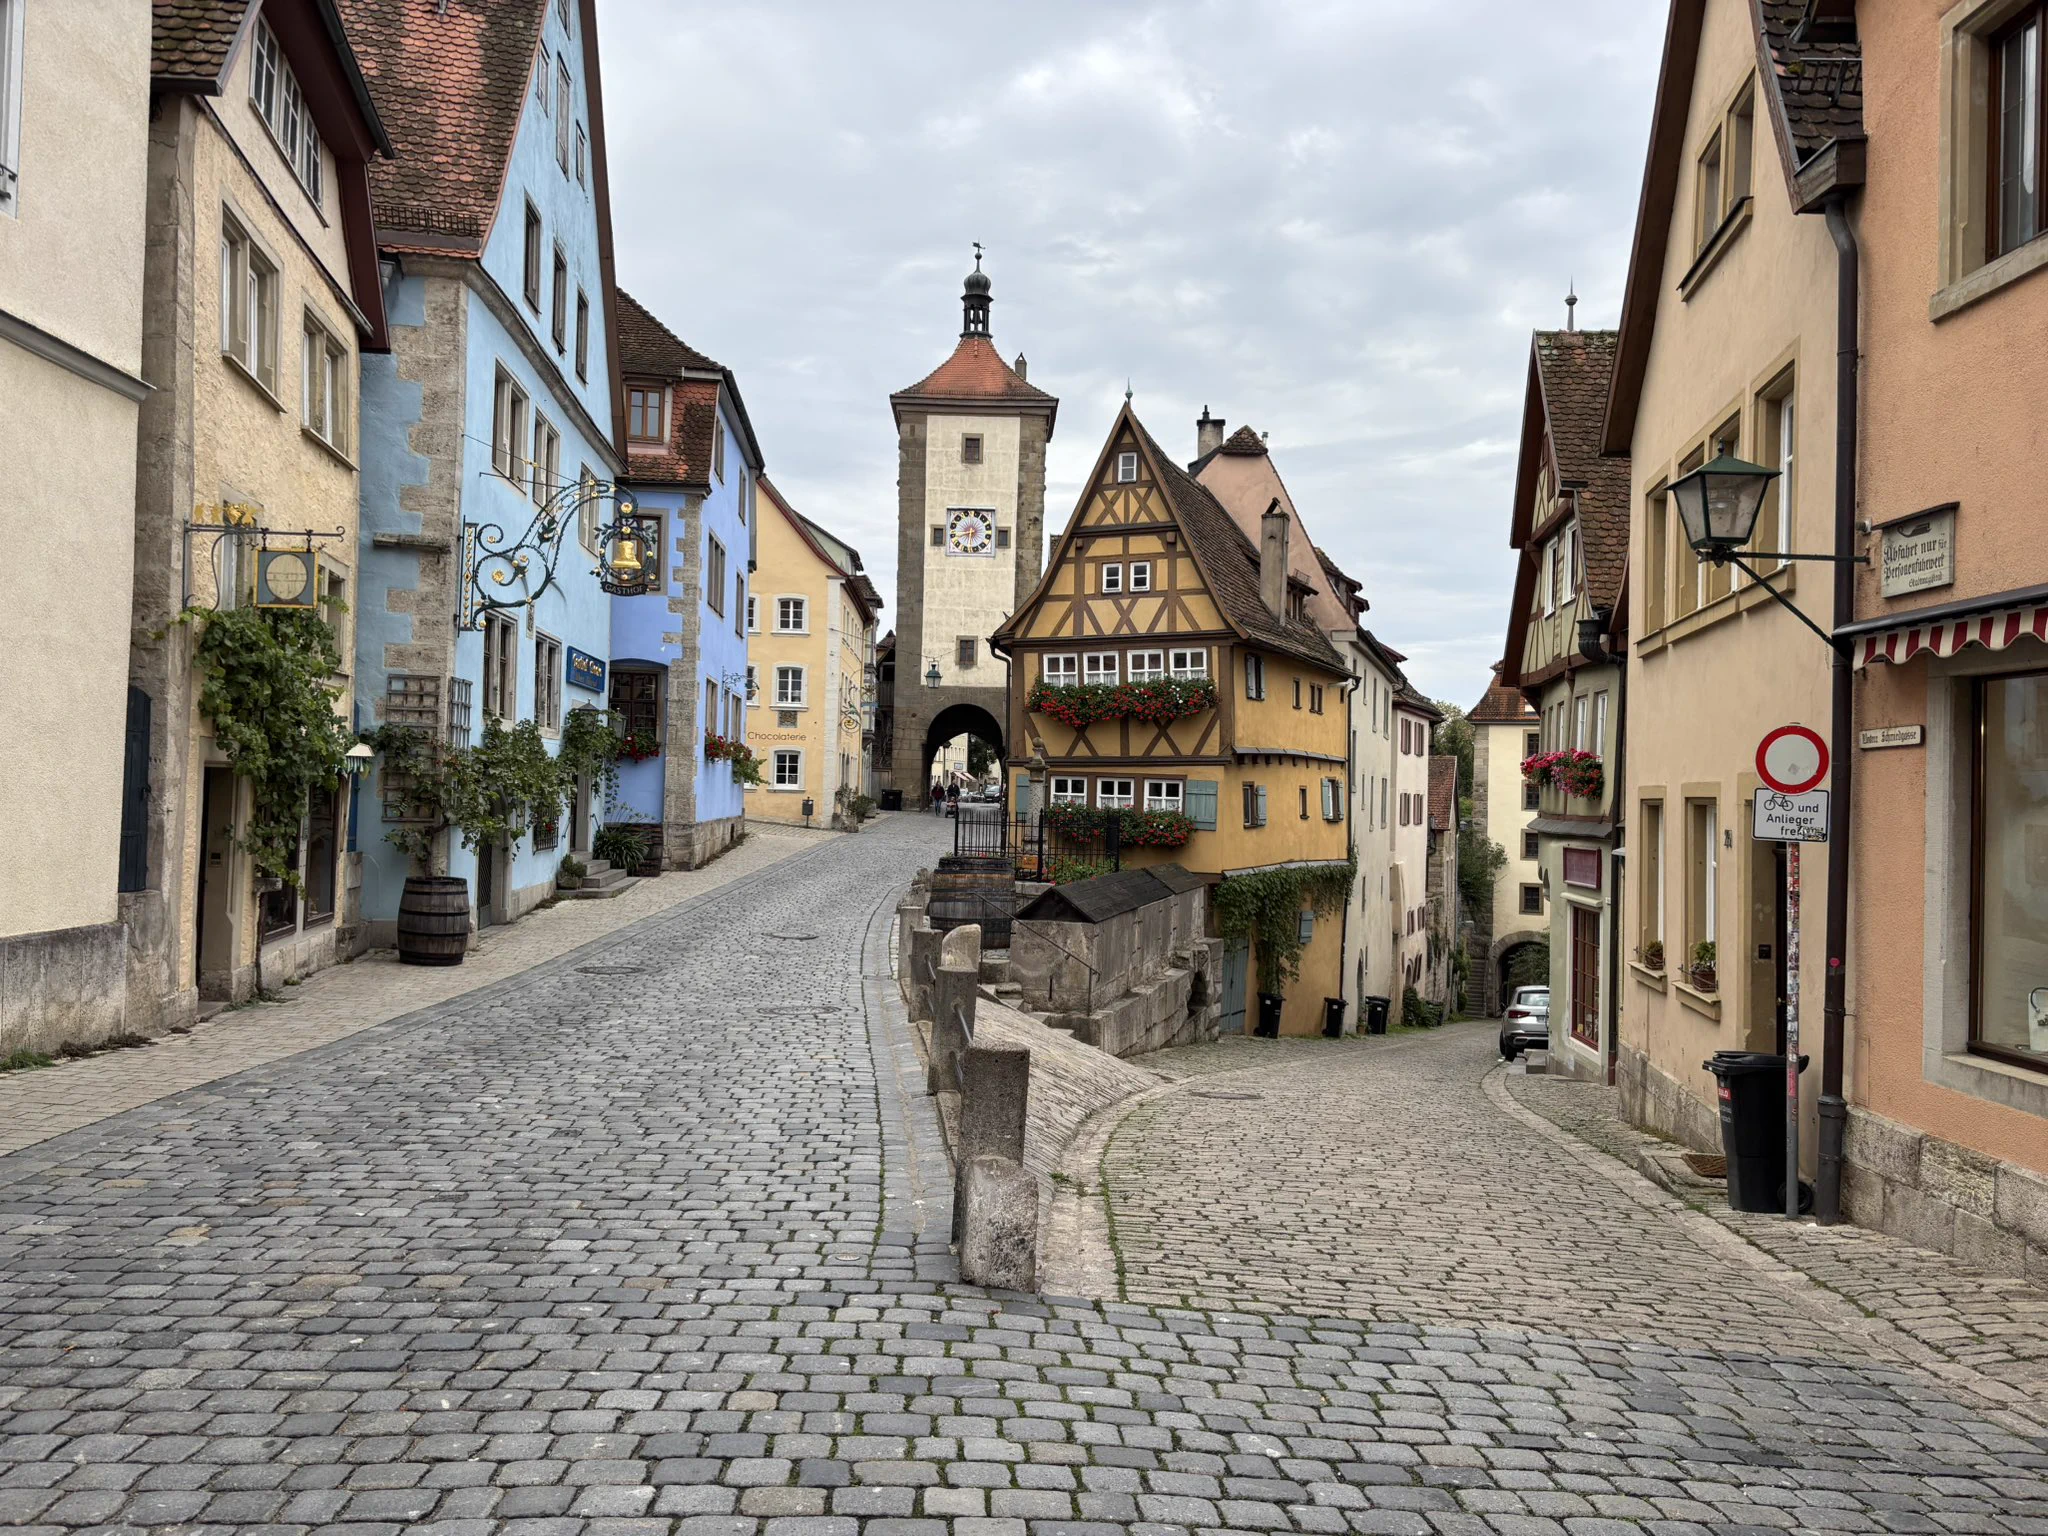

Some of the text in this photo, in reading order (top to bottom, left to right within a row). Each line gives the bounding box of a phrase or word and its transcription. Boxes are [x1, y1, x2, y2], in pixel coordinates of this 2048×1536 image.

[1884, 543, 1918, 565] Abfahrt
[1921, 540, 1937, 554] nur
[605, 584, 645, 595] GASTHOF
[747, 731, 807, 741] Chocolaterie
[1798, 804, 1819, 813] und
[1766, 813, 1815, 827] Anlieger
